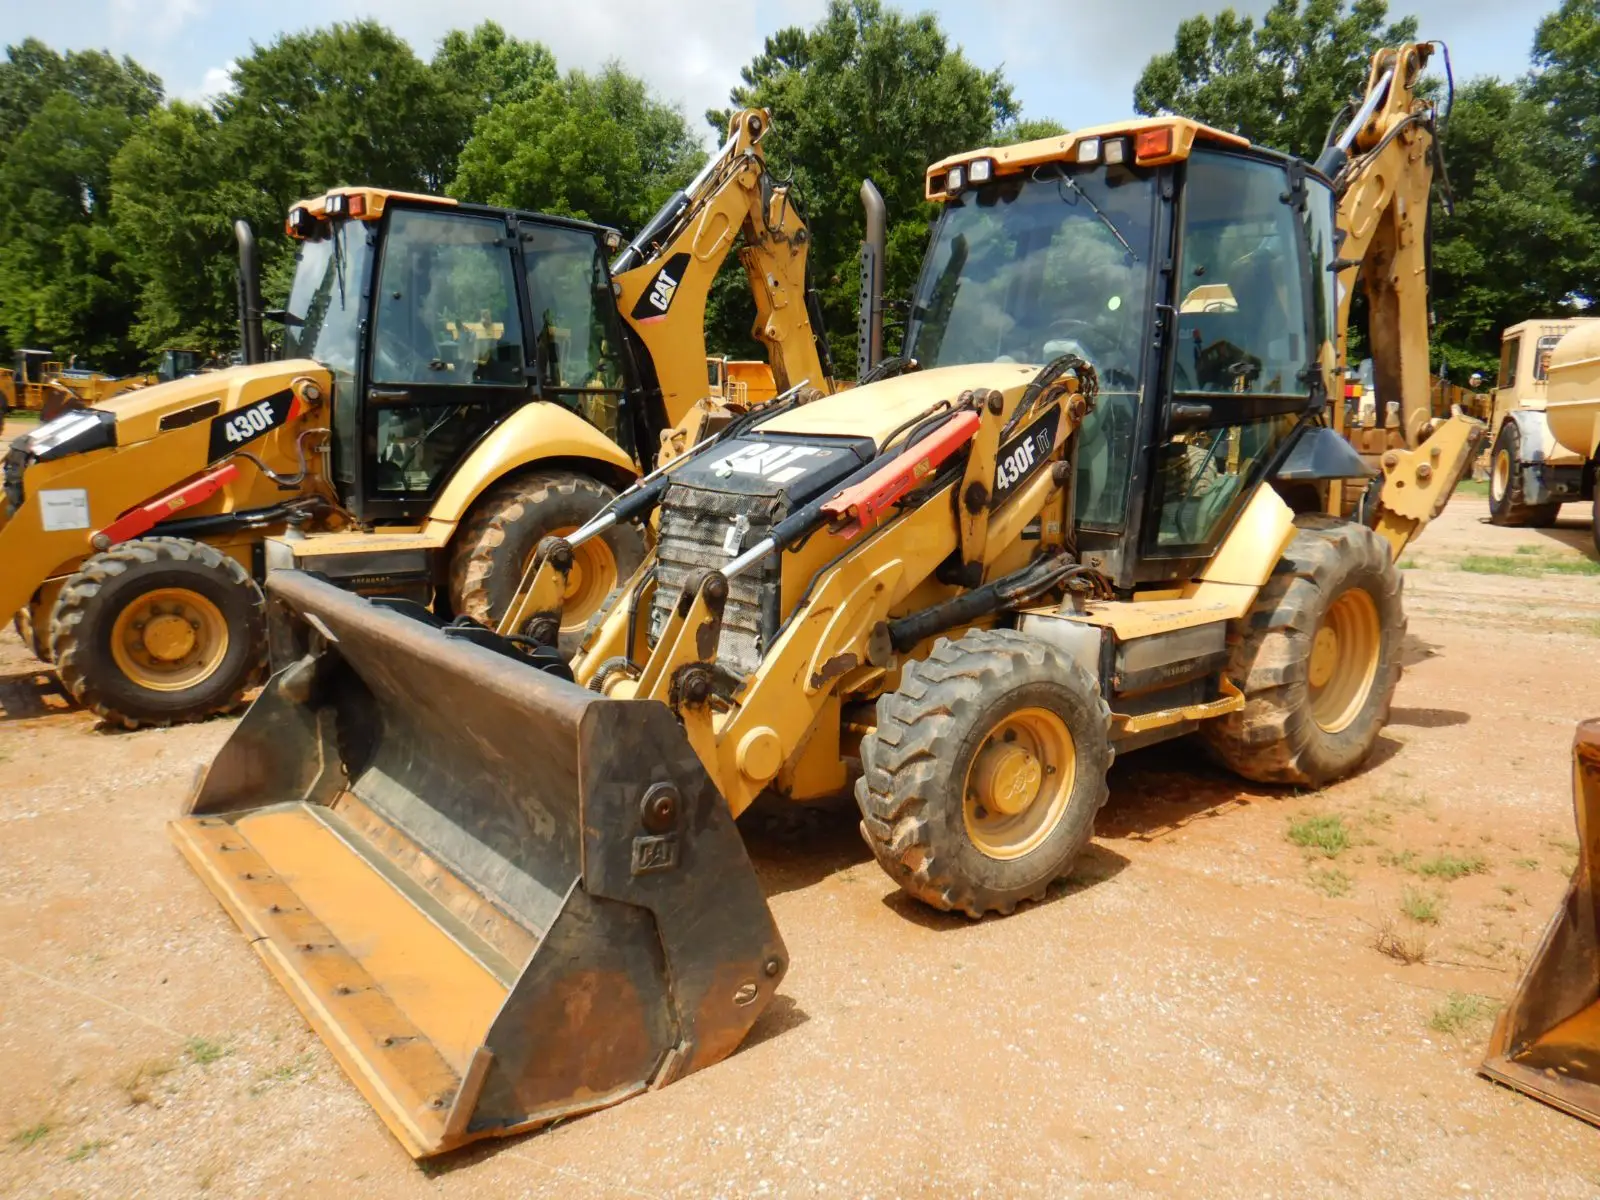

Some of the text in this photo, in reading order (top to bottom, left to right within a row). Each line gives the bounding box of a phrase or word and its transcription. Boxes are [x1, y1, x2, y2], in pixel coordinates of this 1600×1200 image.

[650, 269, 677, 311] CAT
[225, 401, 274, 442] 430F
[709, 443, 821, 476] CAT
[997, 427, 1050, 490] 430F IT
